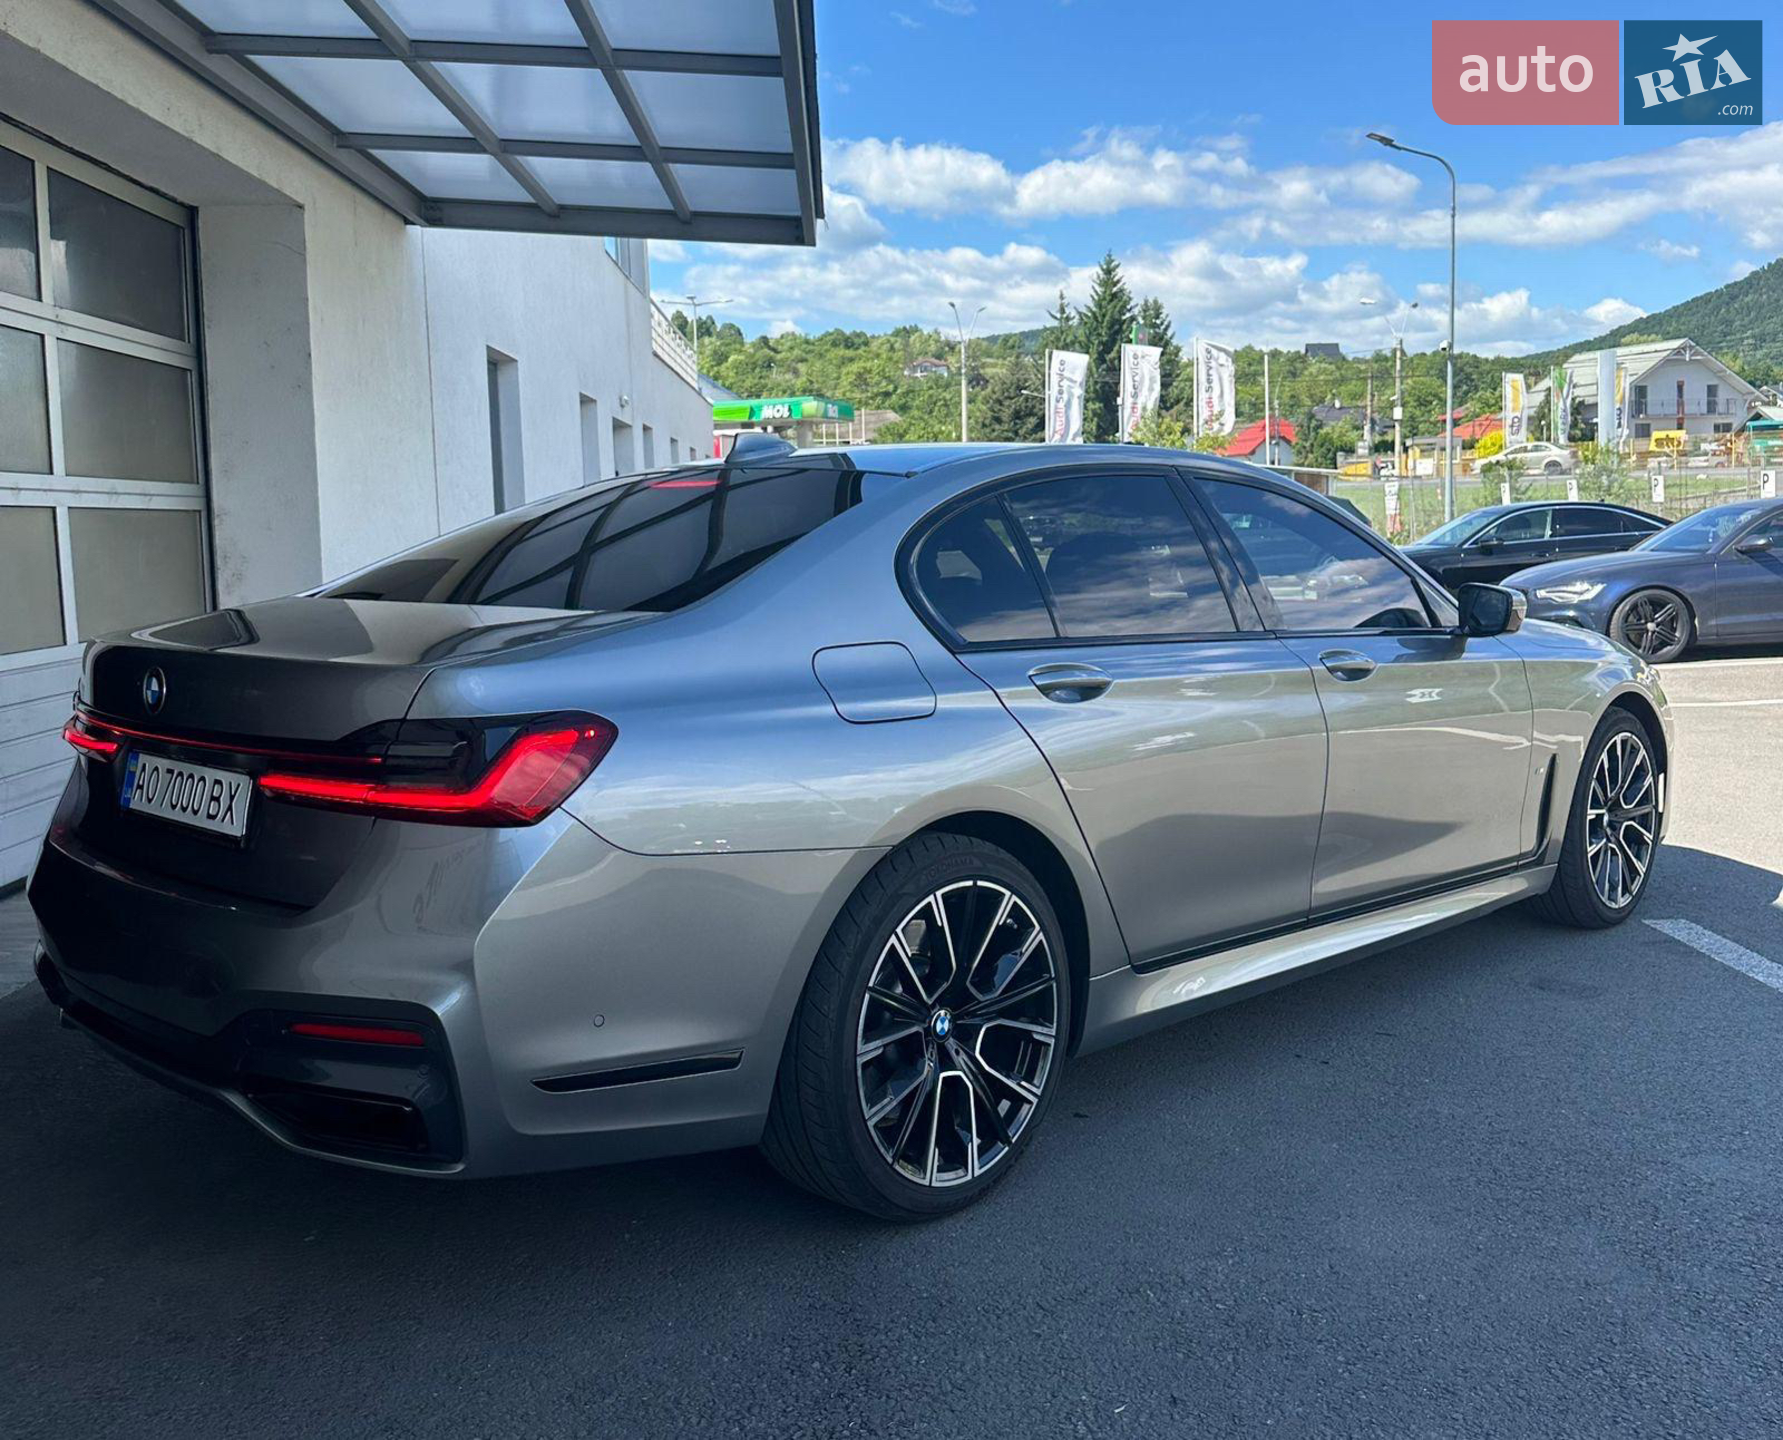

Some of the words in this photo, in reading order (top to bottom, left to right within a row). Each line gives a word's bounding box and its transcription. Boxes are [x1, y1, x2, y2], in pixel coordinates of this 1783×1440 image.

[1055, 359, 1066, 404] Service
[1130, 353, 1140, 399] Service
[1204, 347, 1214, 393] Service
[763, 404, 791, 419] MOL
[1054, 405, 1066, 438] Audi
[1653, 478, 1659, 493] P
[1762, 473, 1769, 490] P
[133, 763, 160, 805] AO
[160, 768, 206, 816] 7000
[206, 777, 241, 826] BX
